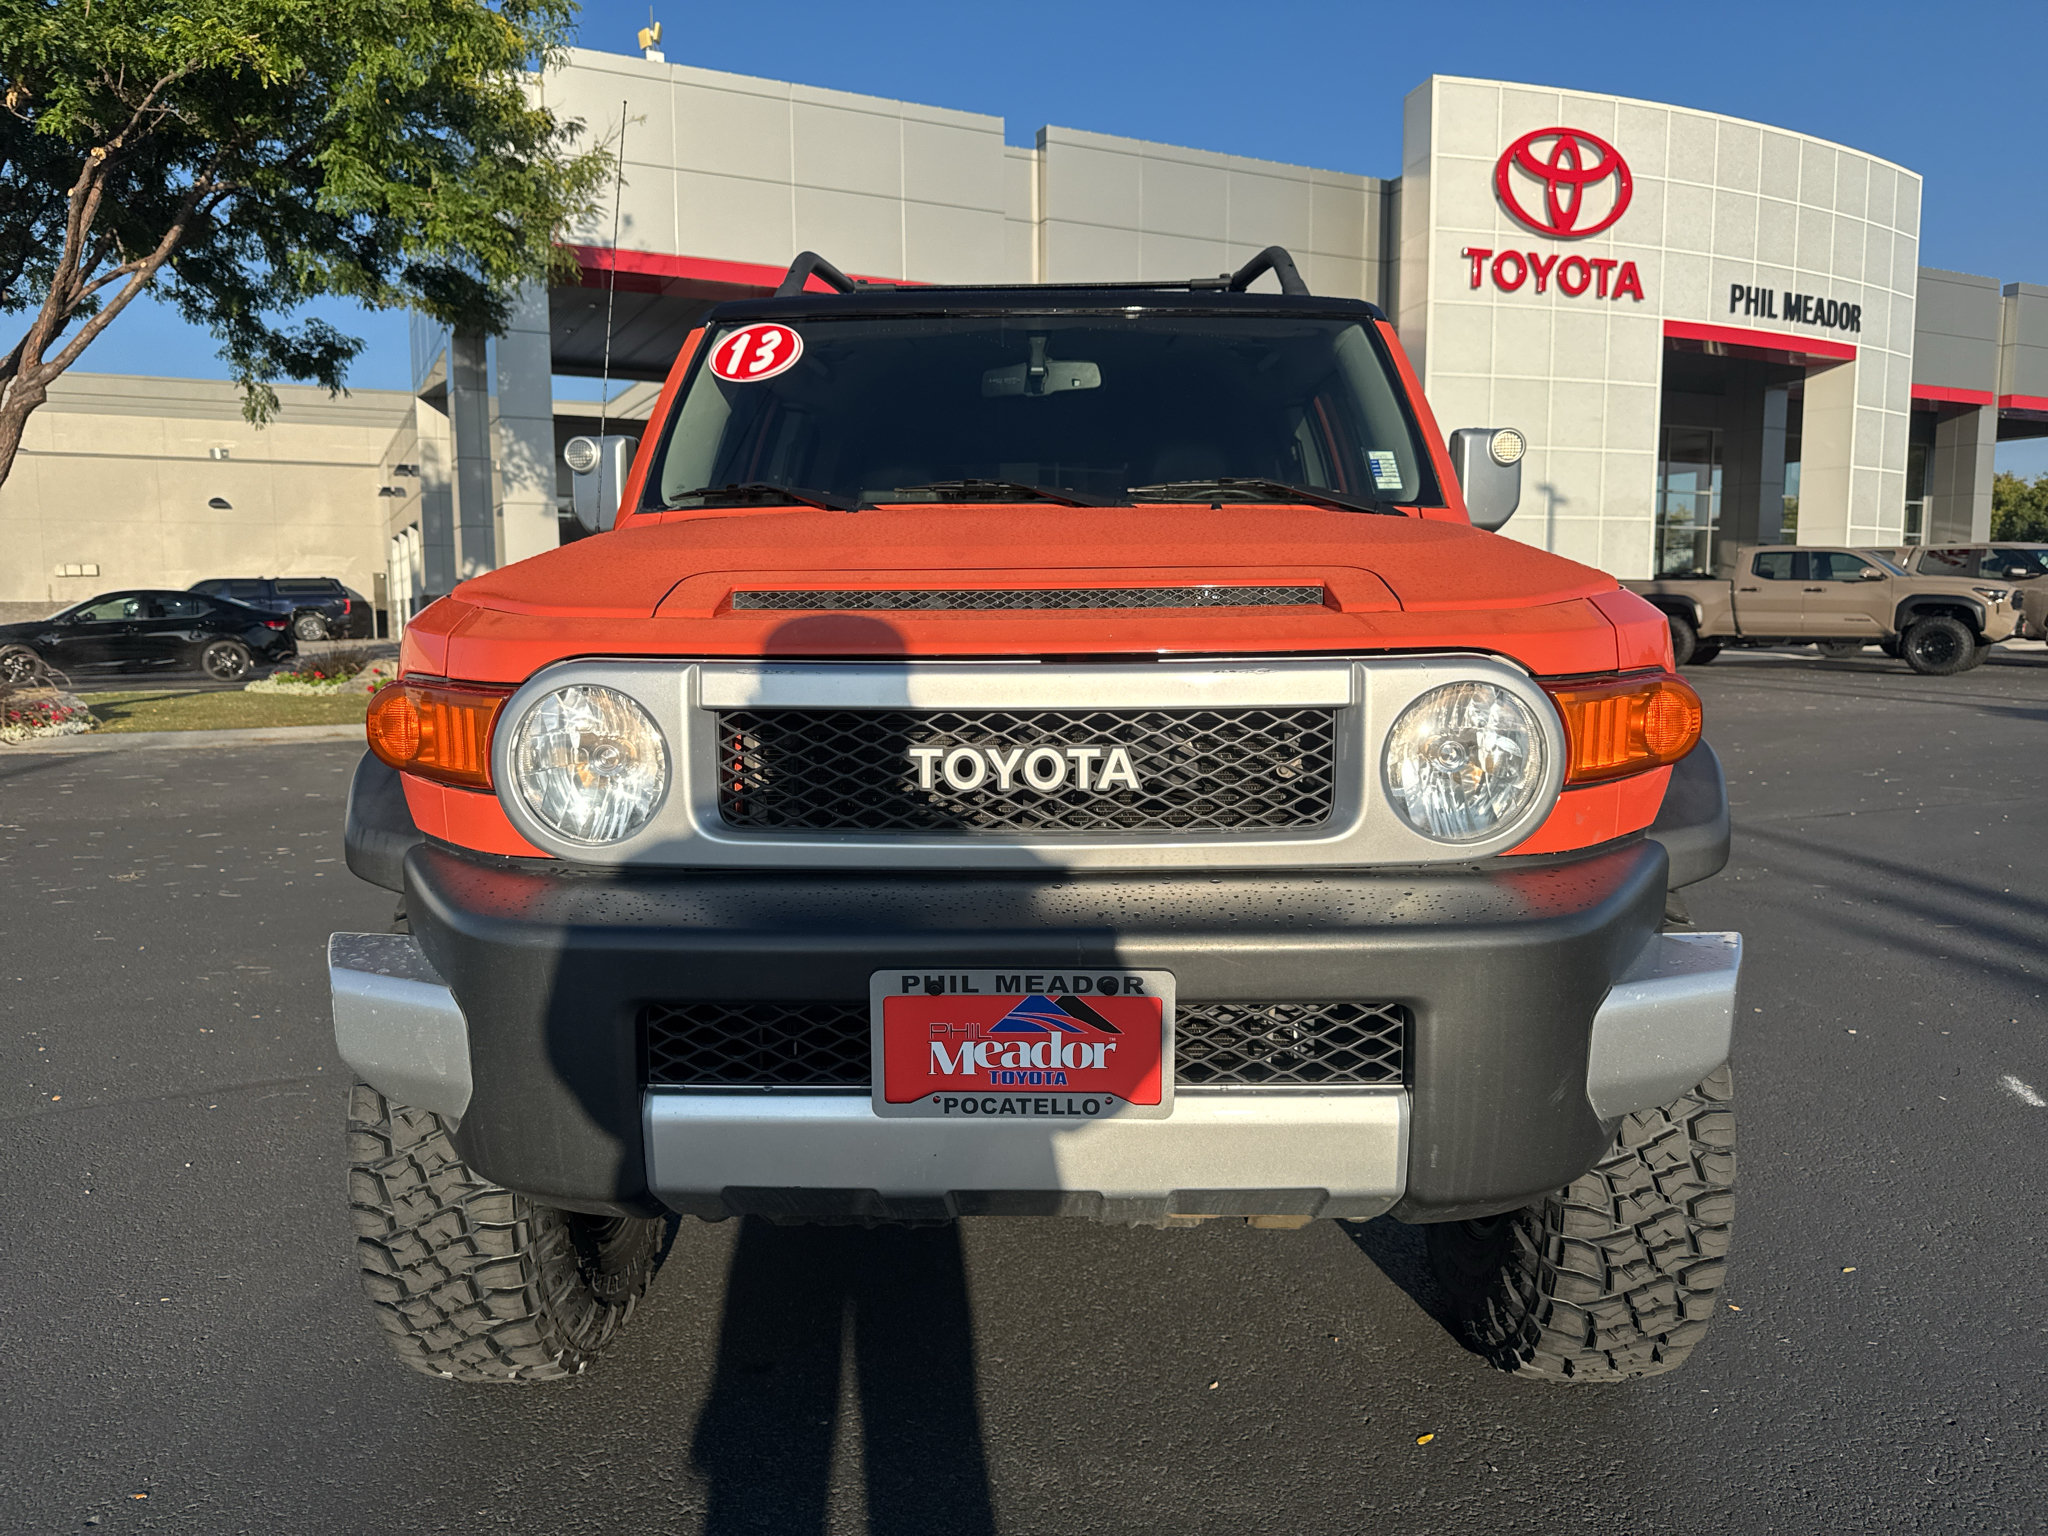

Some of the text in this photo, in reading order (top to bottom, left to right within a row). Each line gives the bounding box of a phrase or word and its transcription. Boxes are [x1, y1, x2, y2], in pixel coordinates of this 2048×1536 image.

[1462, 247, 1645, 301] TOYOTA
[1730, 284, 1861, 333] PHIL MEADOR
[726, 330, 783, 375] 13
[907, 746, 1142, 791] TOYOTA
[901, 975, 1145, 994] PHIL MEADOR
[928, 1031, 1117, 1075] Meador
[930, 1023, 992, 1039] PHIL
[988, 1071, 1068, 1086] TOYOTA
[943, 1097, 1100, 1116] POCATELLO
